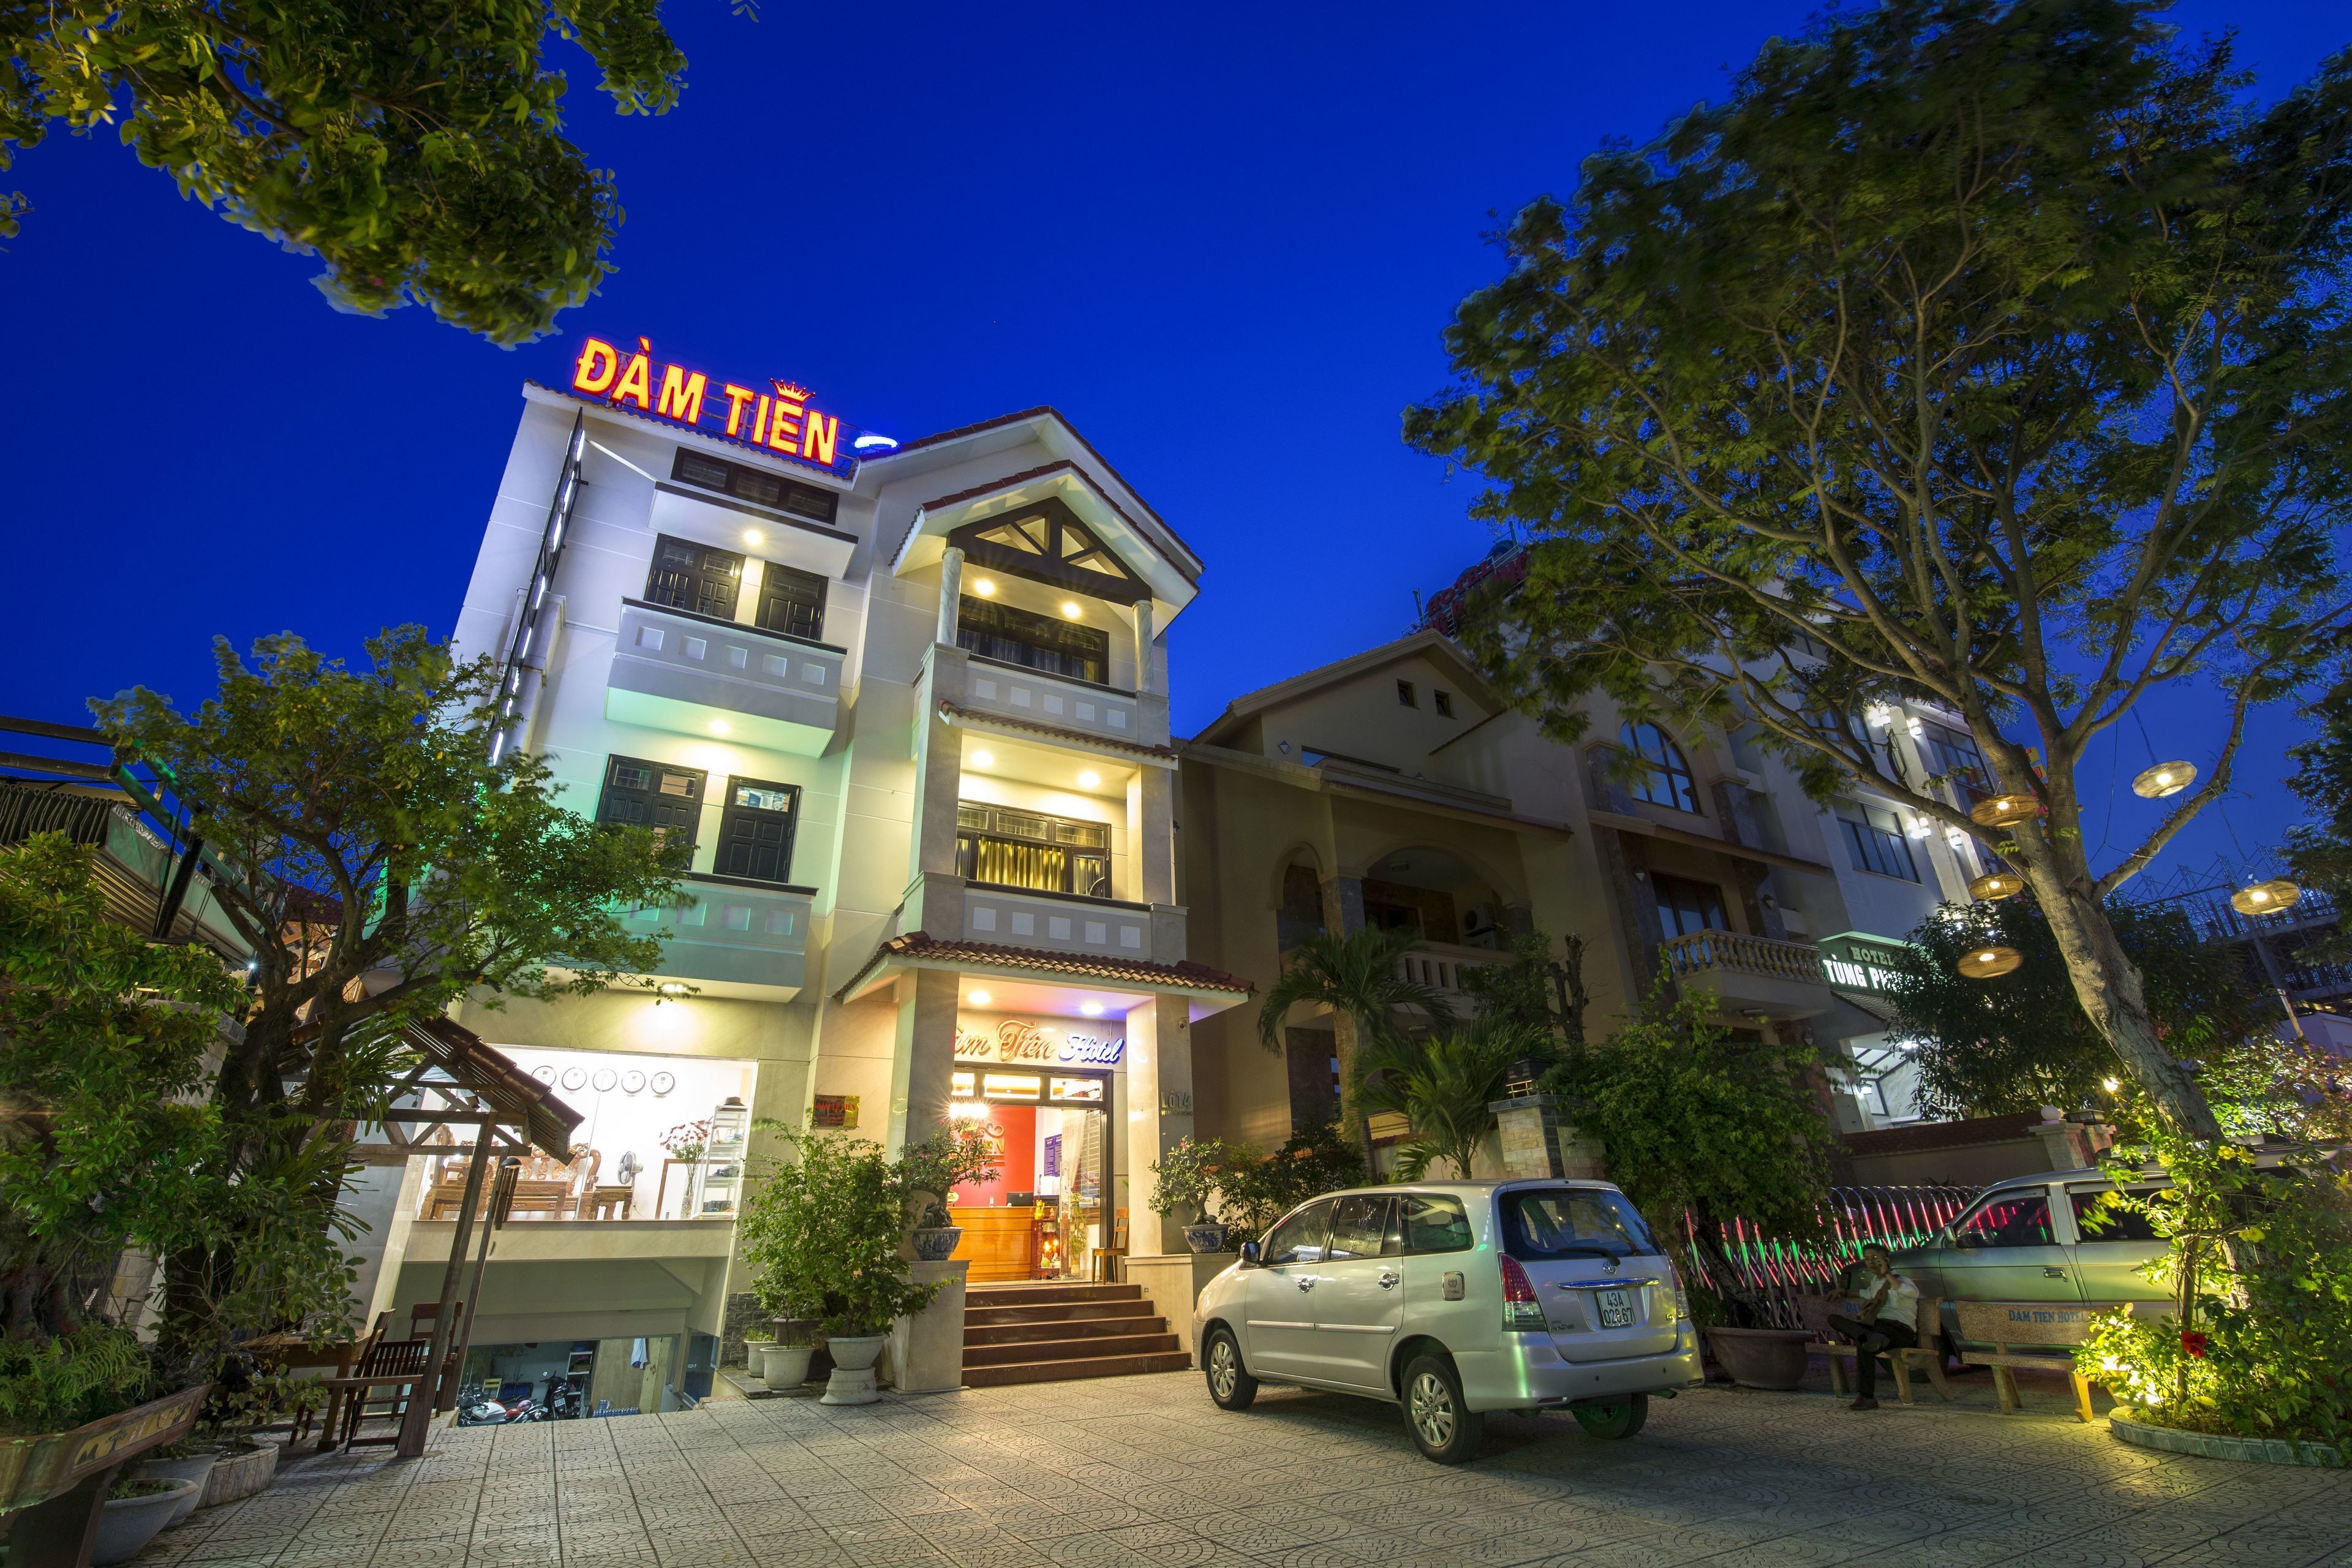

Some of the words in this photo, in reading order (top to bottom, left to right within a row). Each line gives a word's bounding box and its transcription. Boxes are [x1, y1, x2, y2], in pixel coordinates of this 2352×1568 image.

[573, 336, 707, 426] ĐÀM
[1427, 561, 1494, 617] HOTEL
[1822, 954, 1868, 987] TÙNG
[1850, 946, 1894, 967] HOTEL
[1058, 1032, 1125, 1064] Hotel
[1607, 1292, 1624, 1307] 43A
